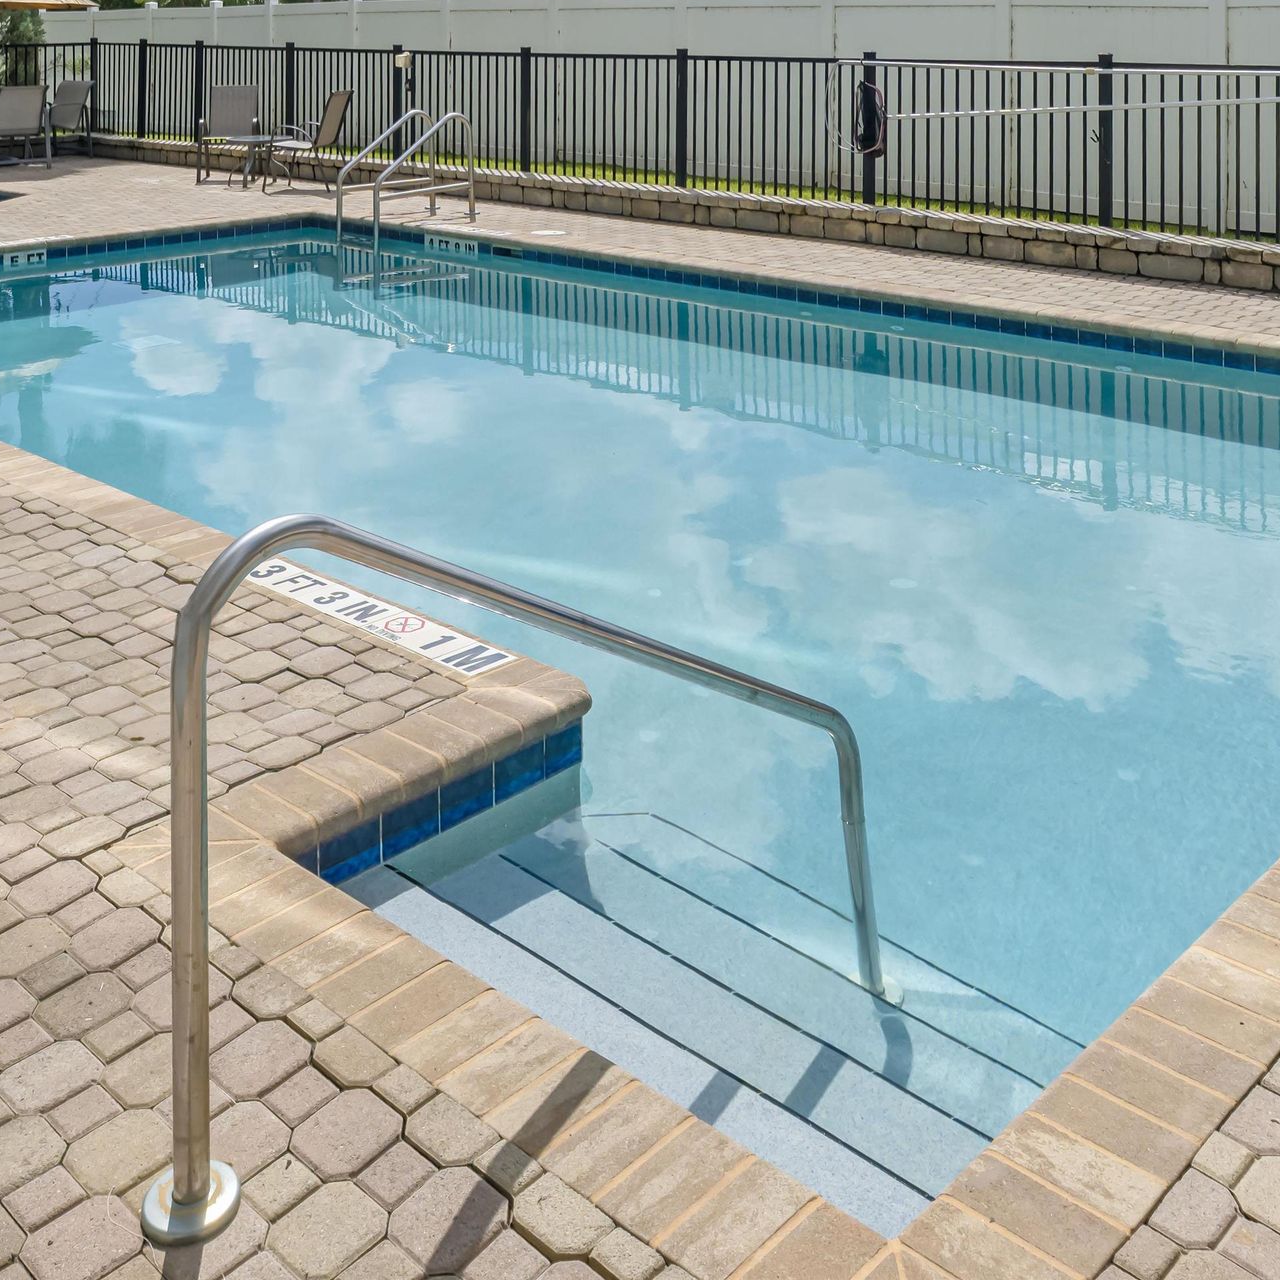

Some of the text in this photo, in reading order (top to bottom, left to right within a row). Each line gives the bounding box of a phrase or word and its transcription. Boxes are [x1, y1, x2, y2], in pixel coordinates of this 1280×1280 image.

[249, 565, 510, 673] 3 FT 3 IN. 1 M
